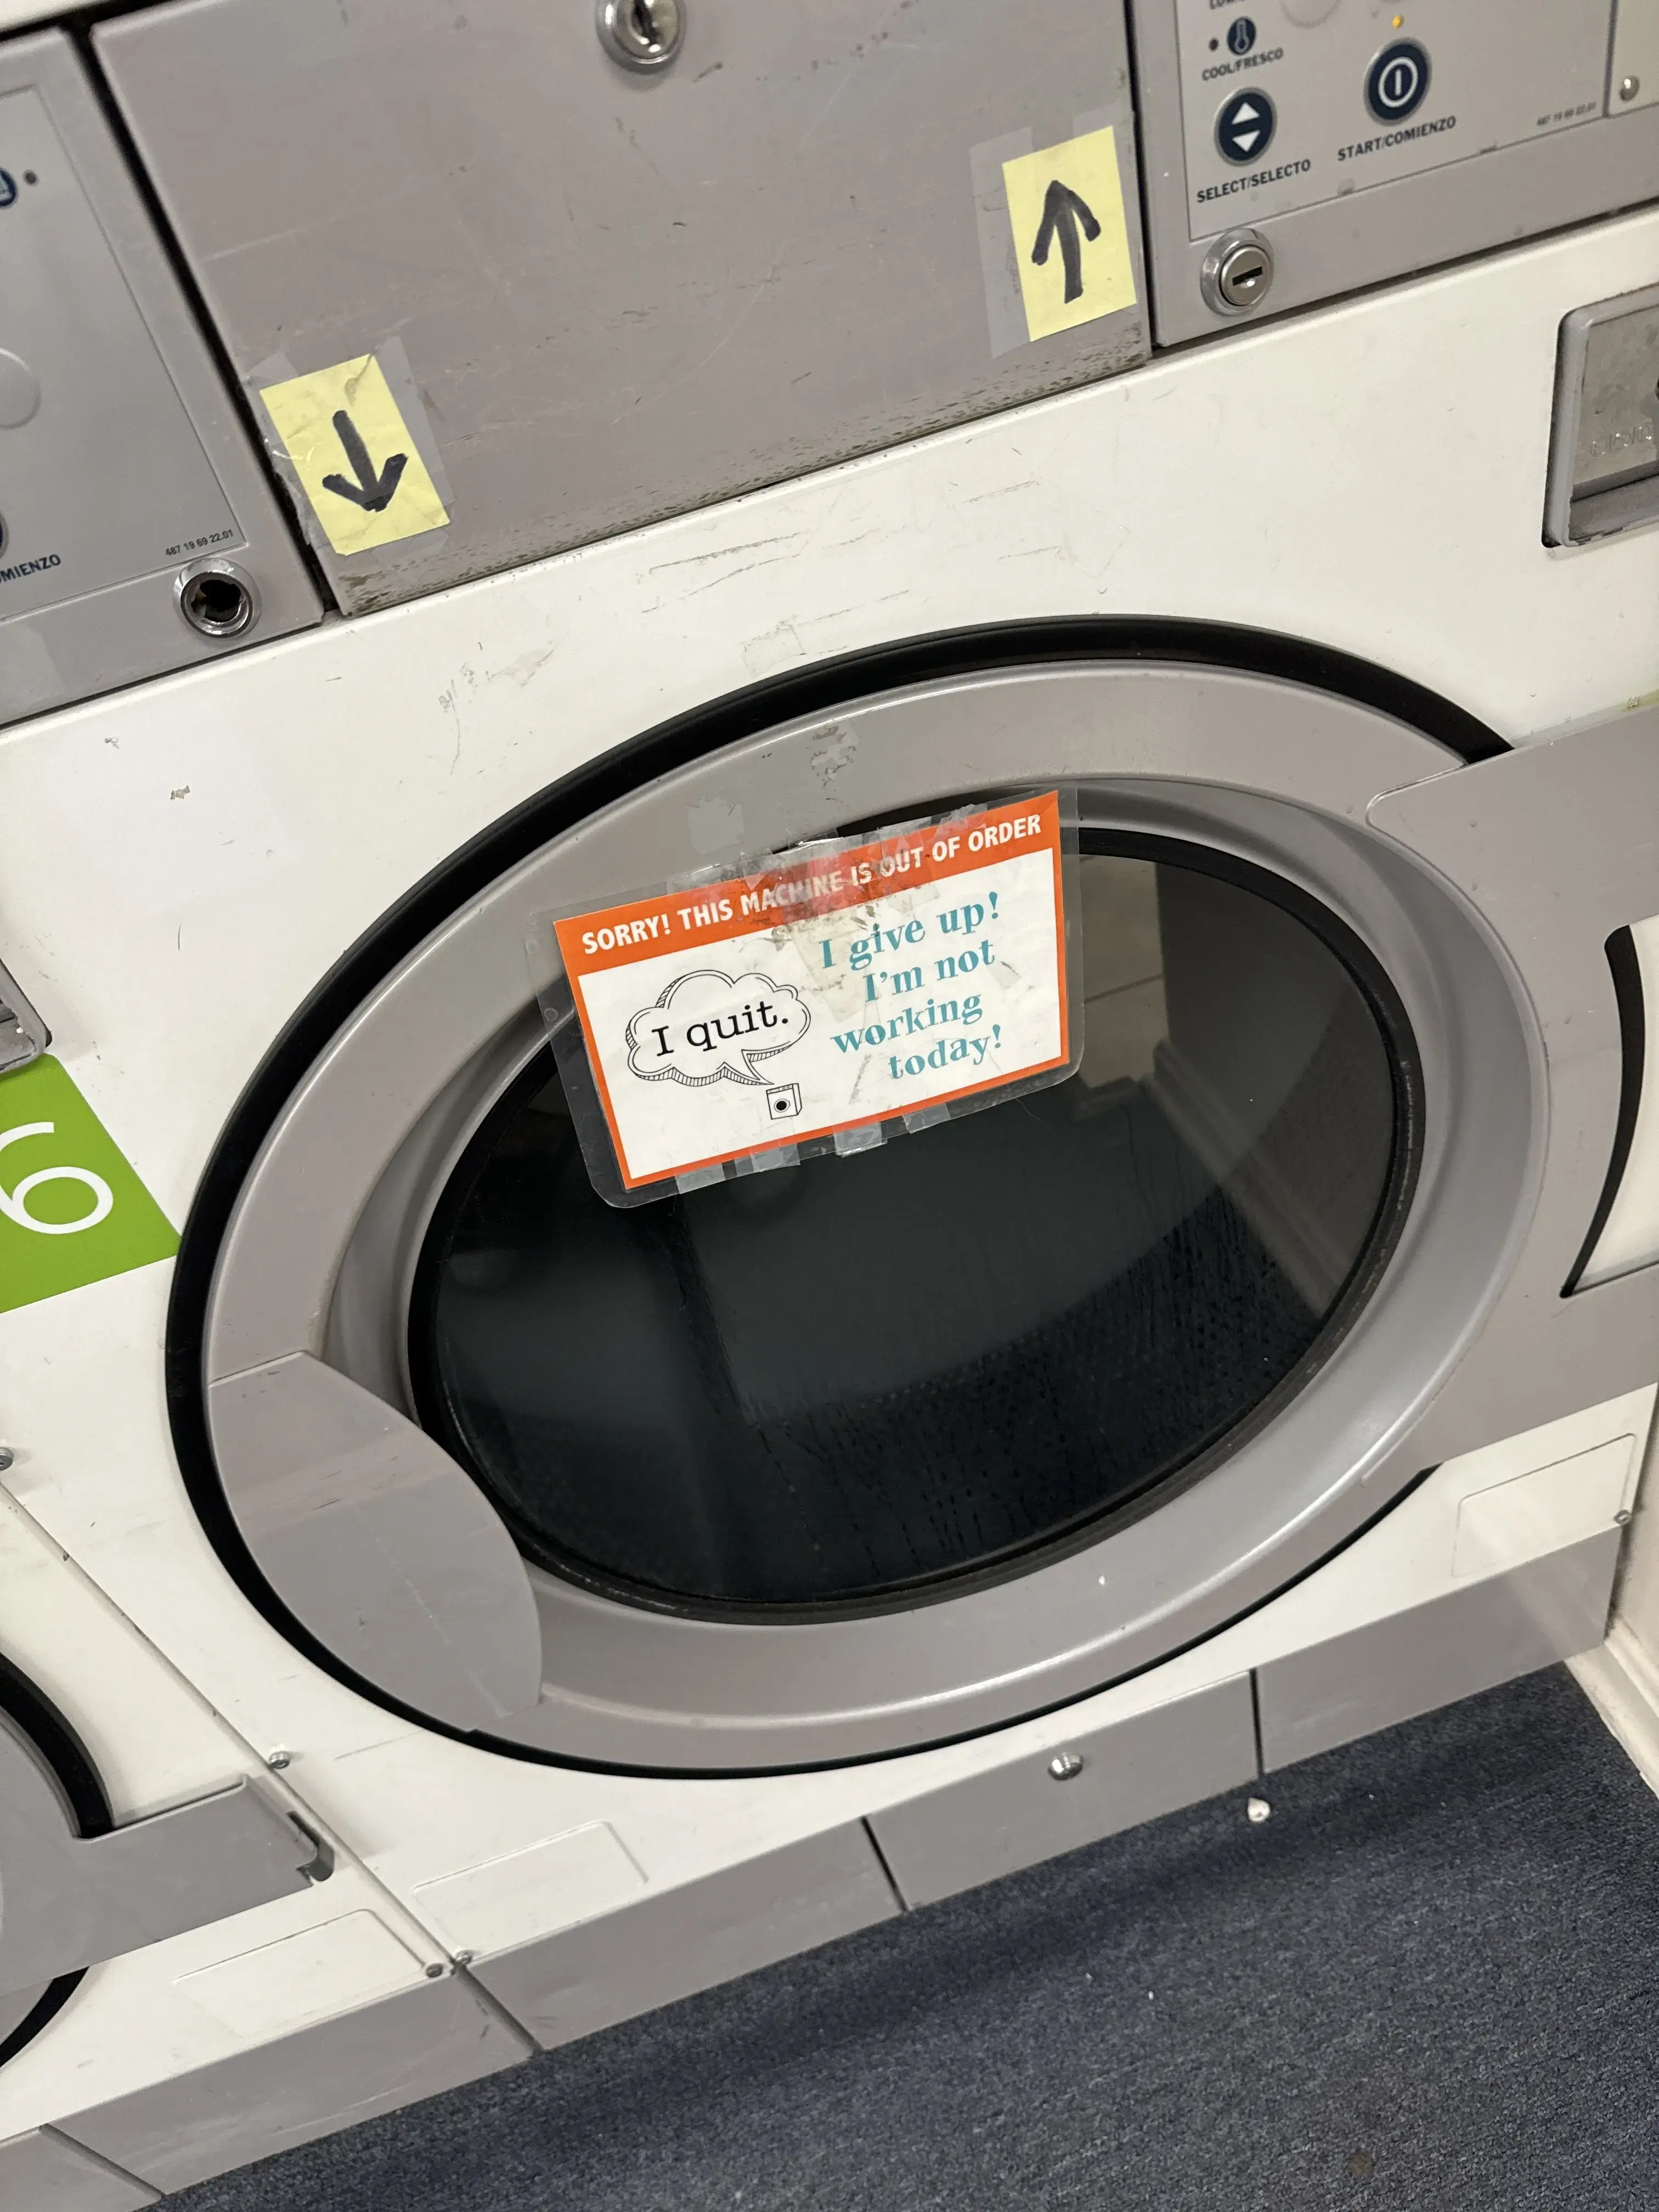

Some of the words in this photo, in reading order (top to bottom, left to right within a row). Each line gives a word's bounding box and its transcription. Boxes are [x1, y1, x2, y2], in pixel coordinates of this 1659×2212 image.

[1202, 47, 1283, 81] COOL/FRESCO
[1338, 116, 1456, 161] START/COMIENZO
[1197, 159, 1311, 203] SELECT/SELECTO
[183, 541, 195, 550] 19
[209, 529, 234, 543] 22.01
[0, 554, 61, 583] MIENZO
[582, 913, 671, 955] SORRY!
[677, 899, 733, 930] THIS
[741, 870, 844, 916] MACHINE
[850, 862, 872, 886] IS
[879, 847, 924, 877] OUT
[932, 836, 960, 862] OF
[968, 814, 1042, 853] ORDER
[819, 939, 836, 969] I
[849, 919, 926, 971] give
[936, 891, 999, 935] up!
[862, 967, 925, 1002] I'm
[934, 939, 995, 981] not
[651, 1025, 674, 1057] I
[686, 1001, 788, 1052] quit.
[830, 995, 983, 1053] working
[888, 1024, 1001, 1079] today!
[0, 1121, 114, 1234] 6
